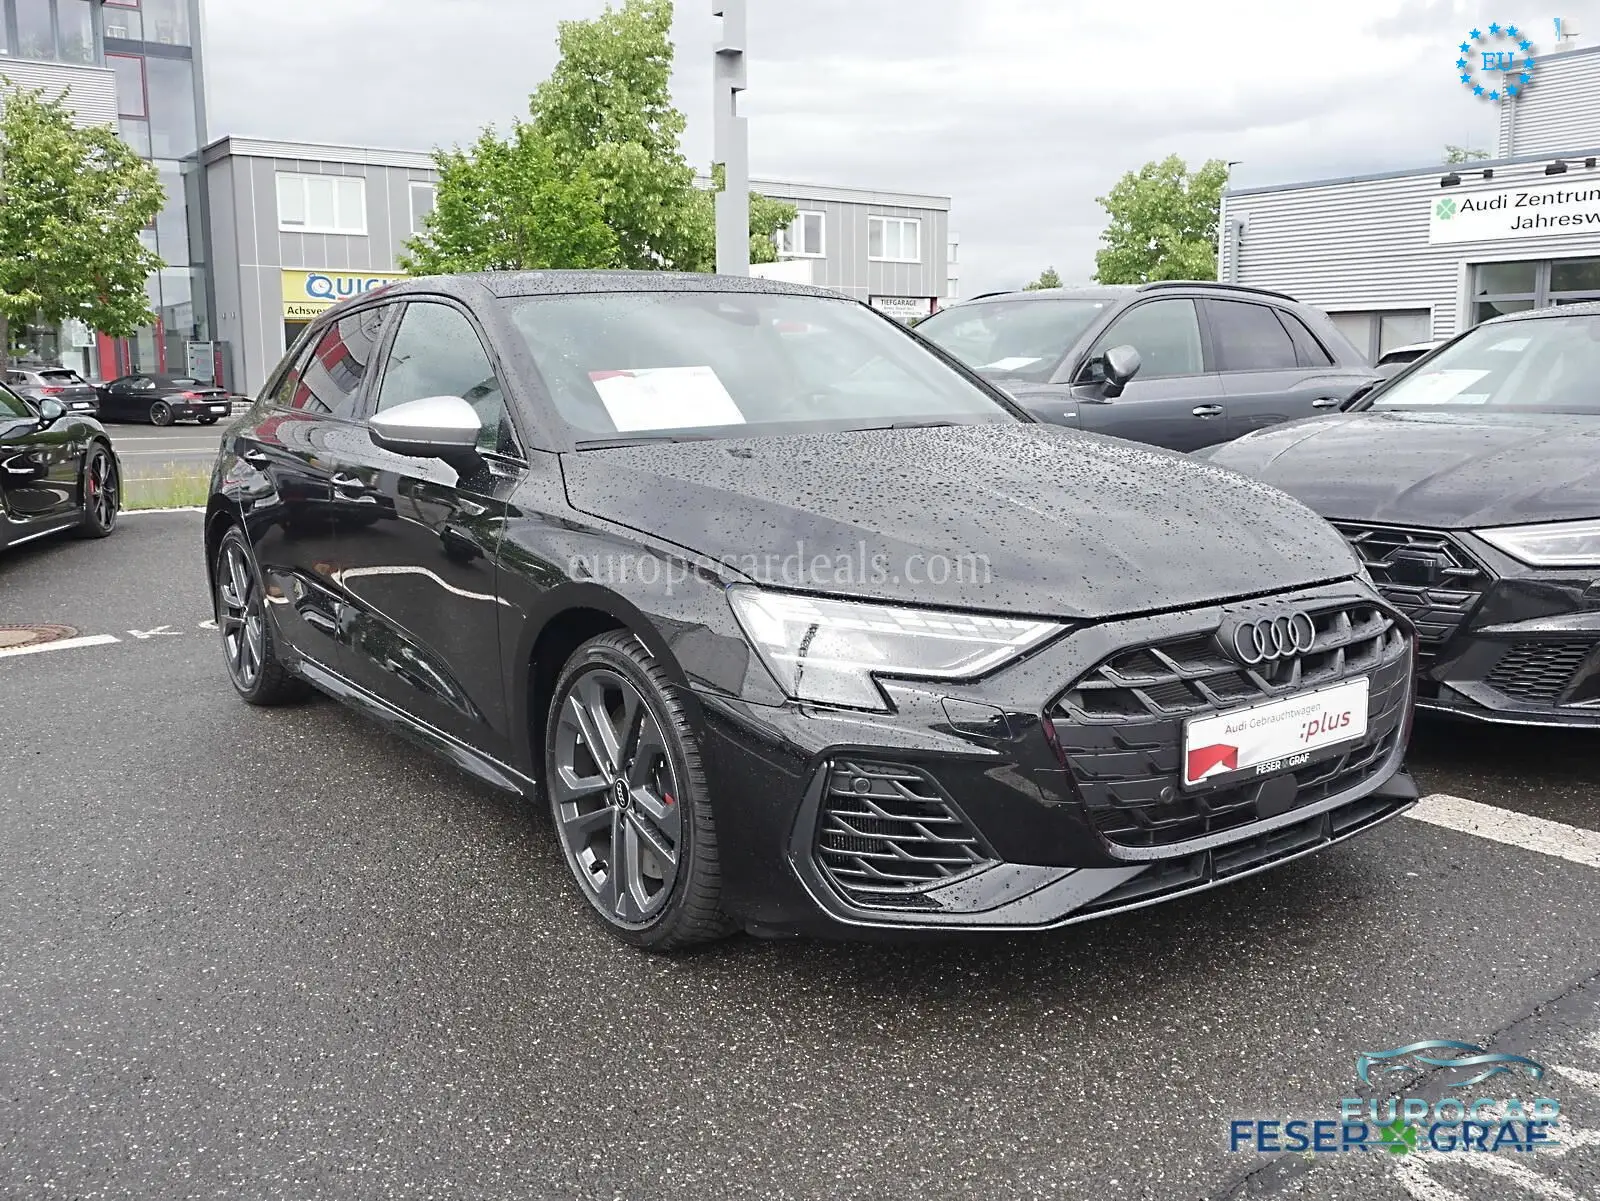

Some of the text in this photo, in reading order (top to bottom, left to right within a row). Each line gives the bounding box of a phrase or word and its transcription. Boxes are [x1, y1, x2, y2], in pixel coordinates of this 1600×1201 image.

[1460, 194, 1507, 212] Audi
[1224, 702, 1321, 735] Audi Gebrauchtwagen
[1256, 753, 1310, 775] FESER GRAF
